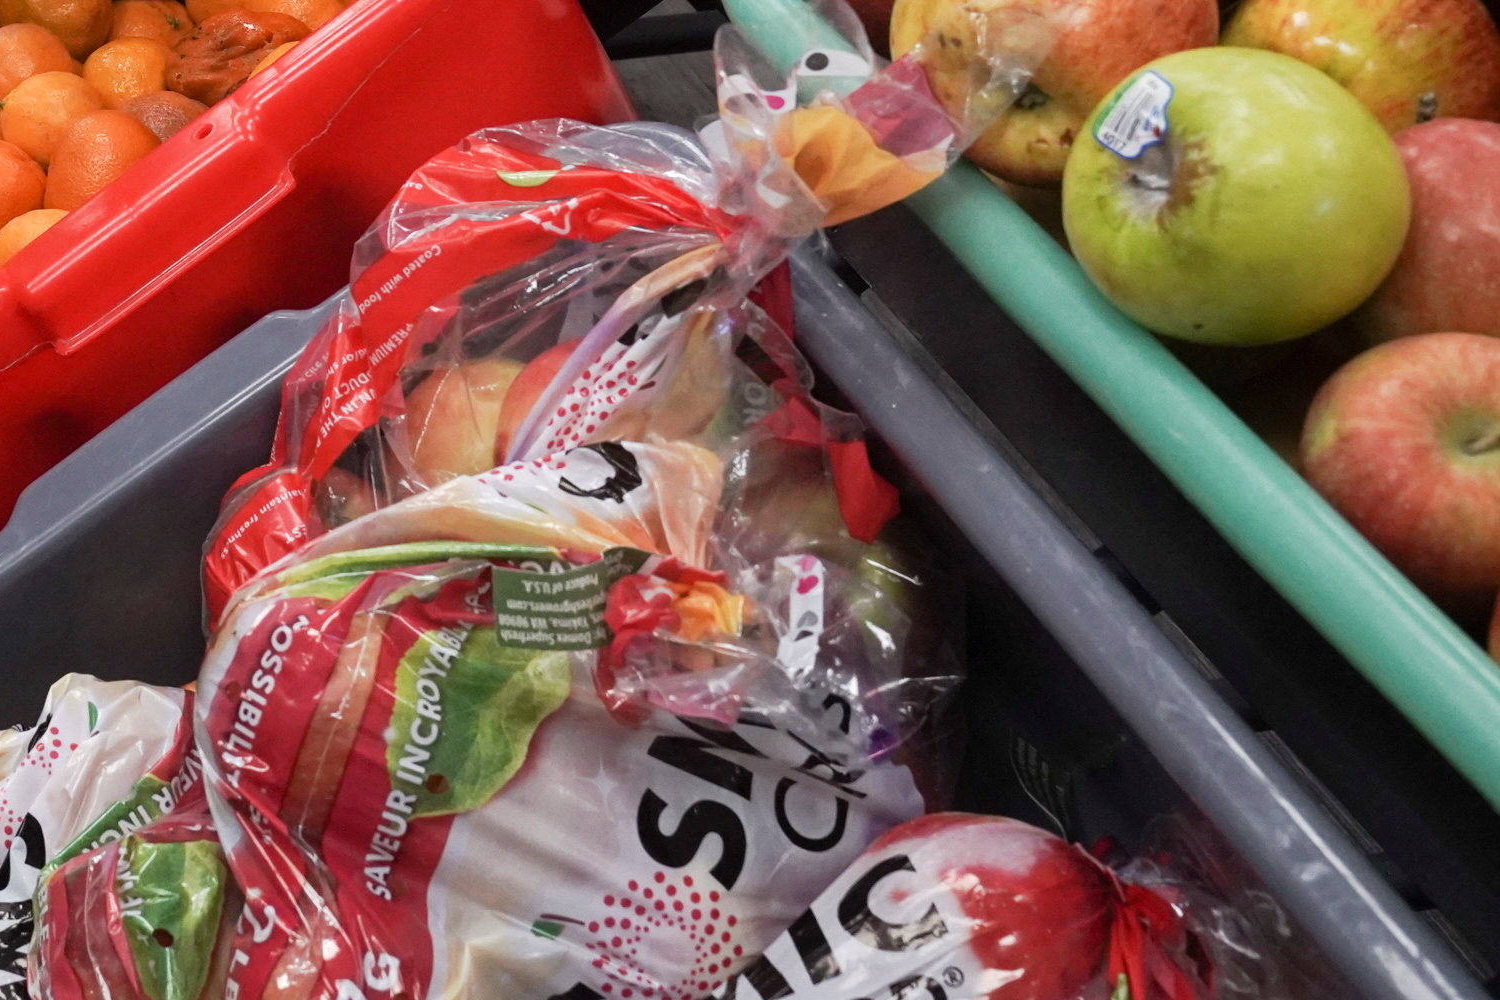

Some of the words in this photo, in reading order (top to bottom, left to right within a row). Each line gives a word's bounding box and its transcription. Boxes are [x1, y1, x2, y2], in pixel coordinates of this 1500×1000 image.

[402, 244, 442, 279] Coated
[380, 273, 403, 294] with
[359, 292, 382, 315] food
[369, 323, 414, 367] PREMIUM
[340, 401, 360, 415] IN
[320, 411, 342, 438] THE
[551, 582, 563, 595] of
[565, 573, 598, 591] Produce
[530, 616, 548, 630] WA
[364, 789, 417, 901] SAVEUR
